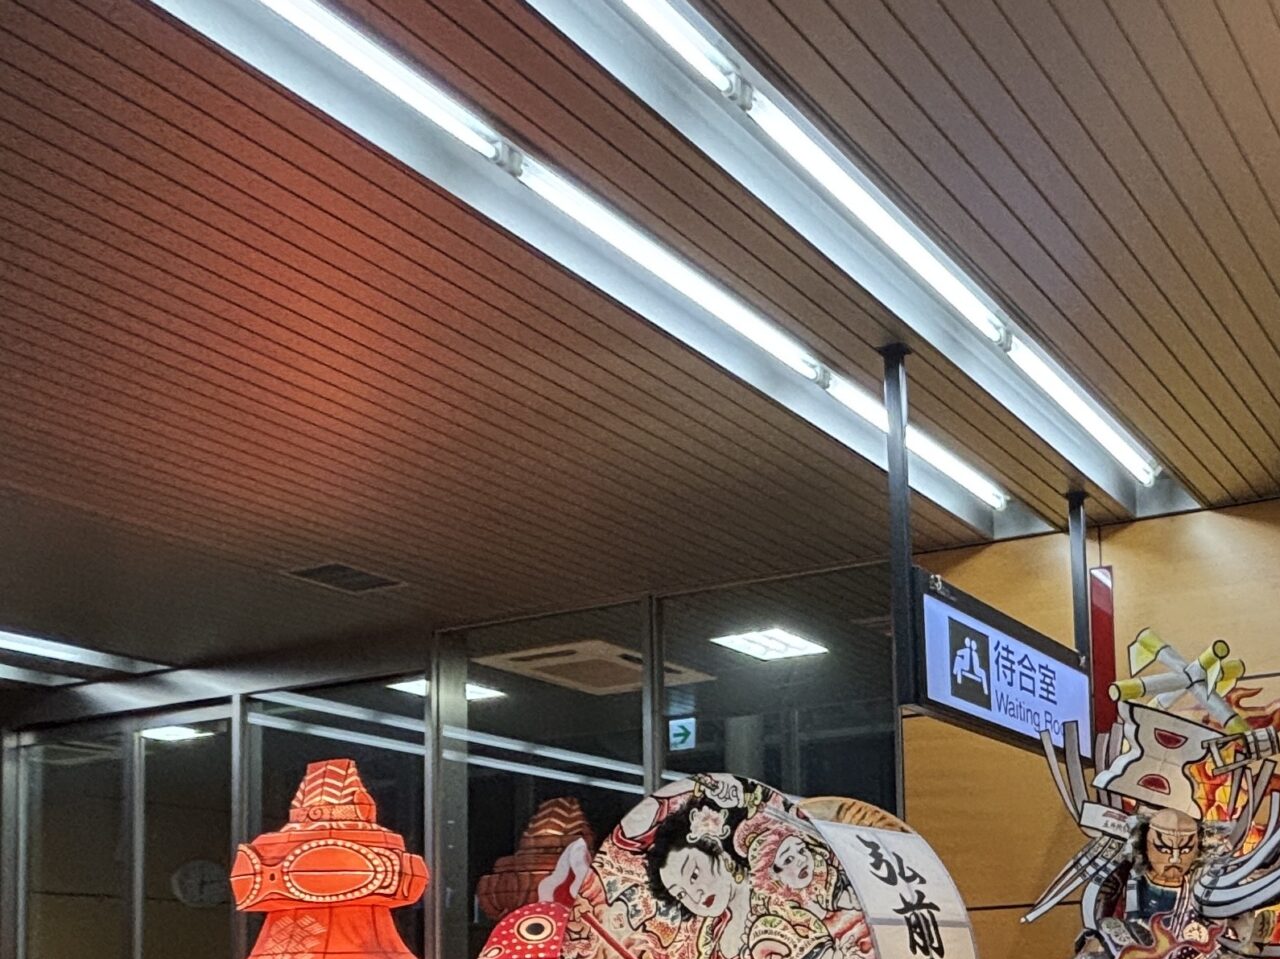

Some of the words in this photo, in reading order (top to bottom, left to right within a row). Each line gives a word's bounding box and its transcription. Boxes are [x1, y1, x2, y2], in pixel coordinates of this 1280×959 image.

[993, 640, 1057, 706] 待合室
[995, 689, 1041, 730] Waiting
